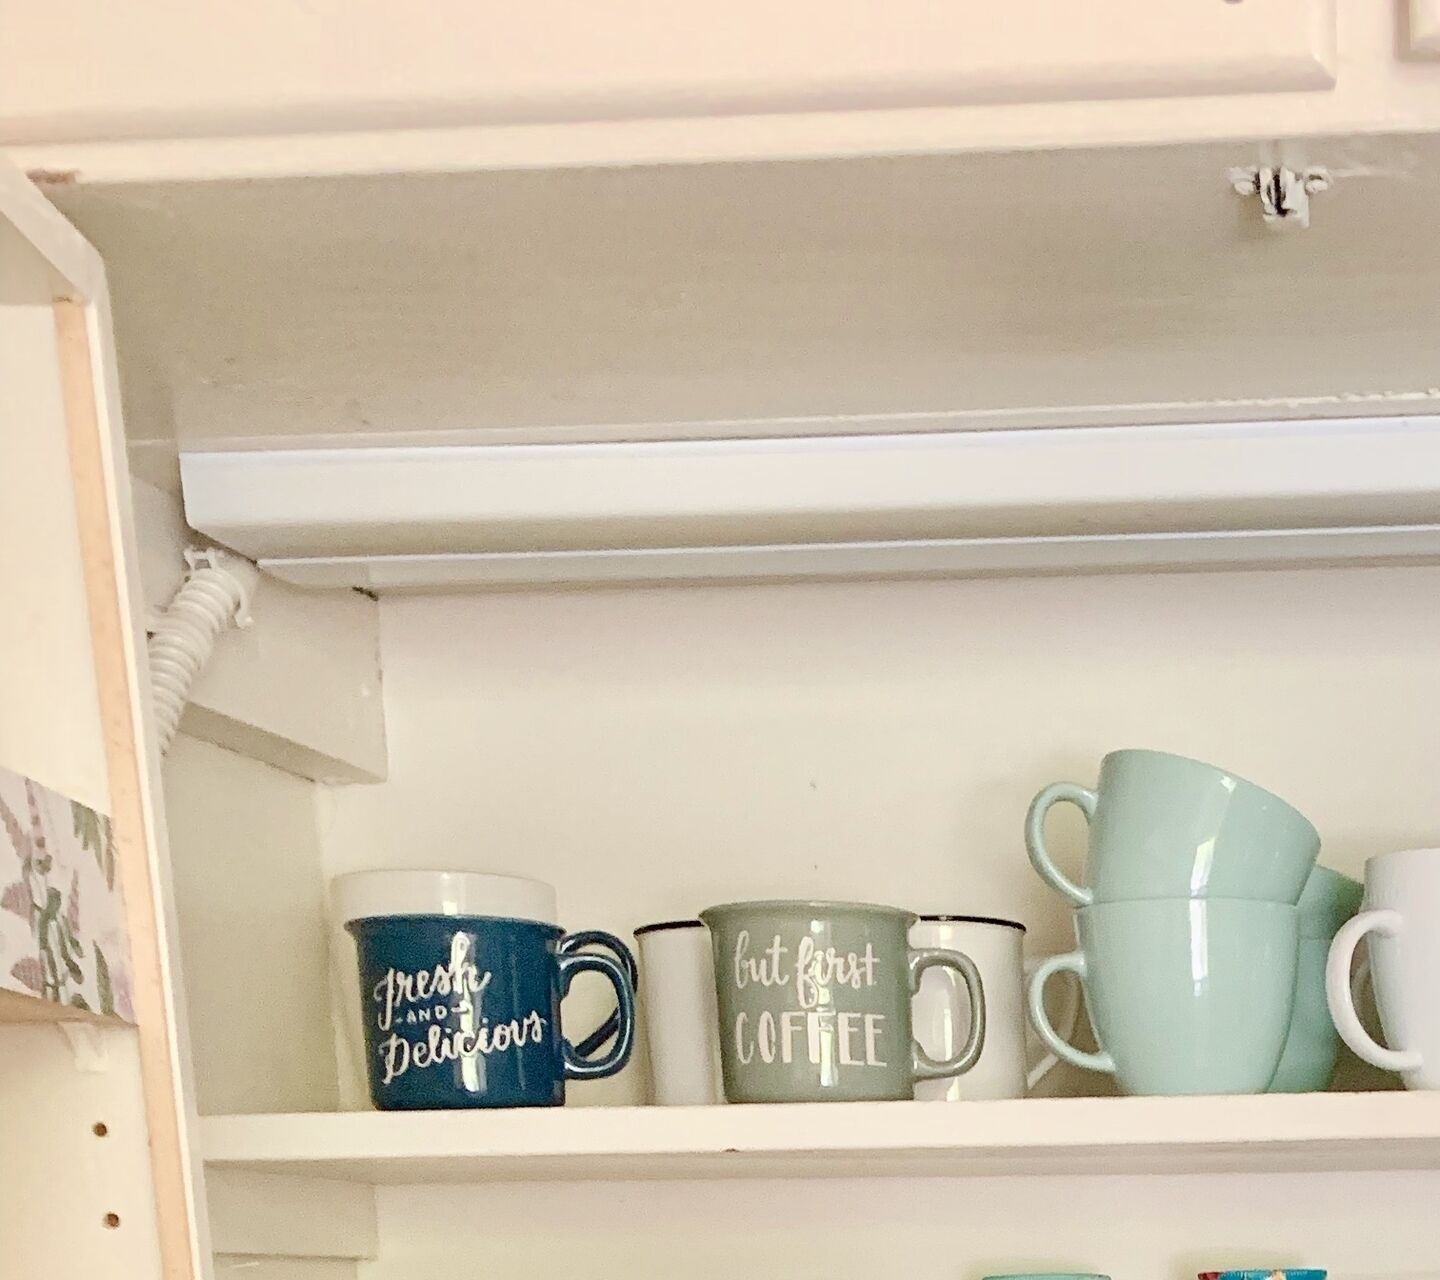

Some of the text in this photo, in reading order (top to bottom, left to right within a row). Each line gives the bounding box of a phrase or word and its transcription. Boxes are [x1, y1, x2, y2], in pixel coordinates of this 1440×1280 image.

[734, 930, 881, 1009] but first
[378, 1010, 547, 1085] Delicious
[735, 1010, 888, 1067] COFFEE
